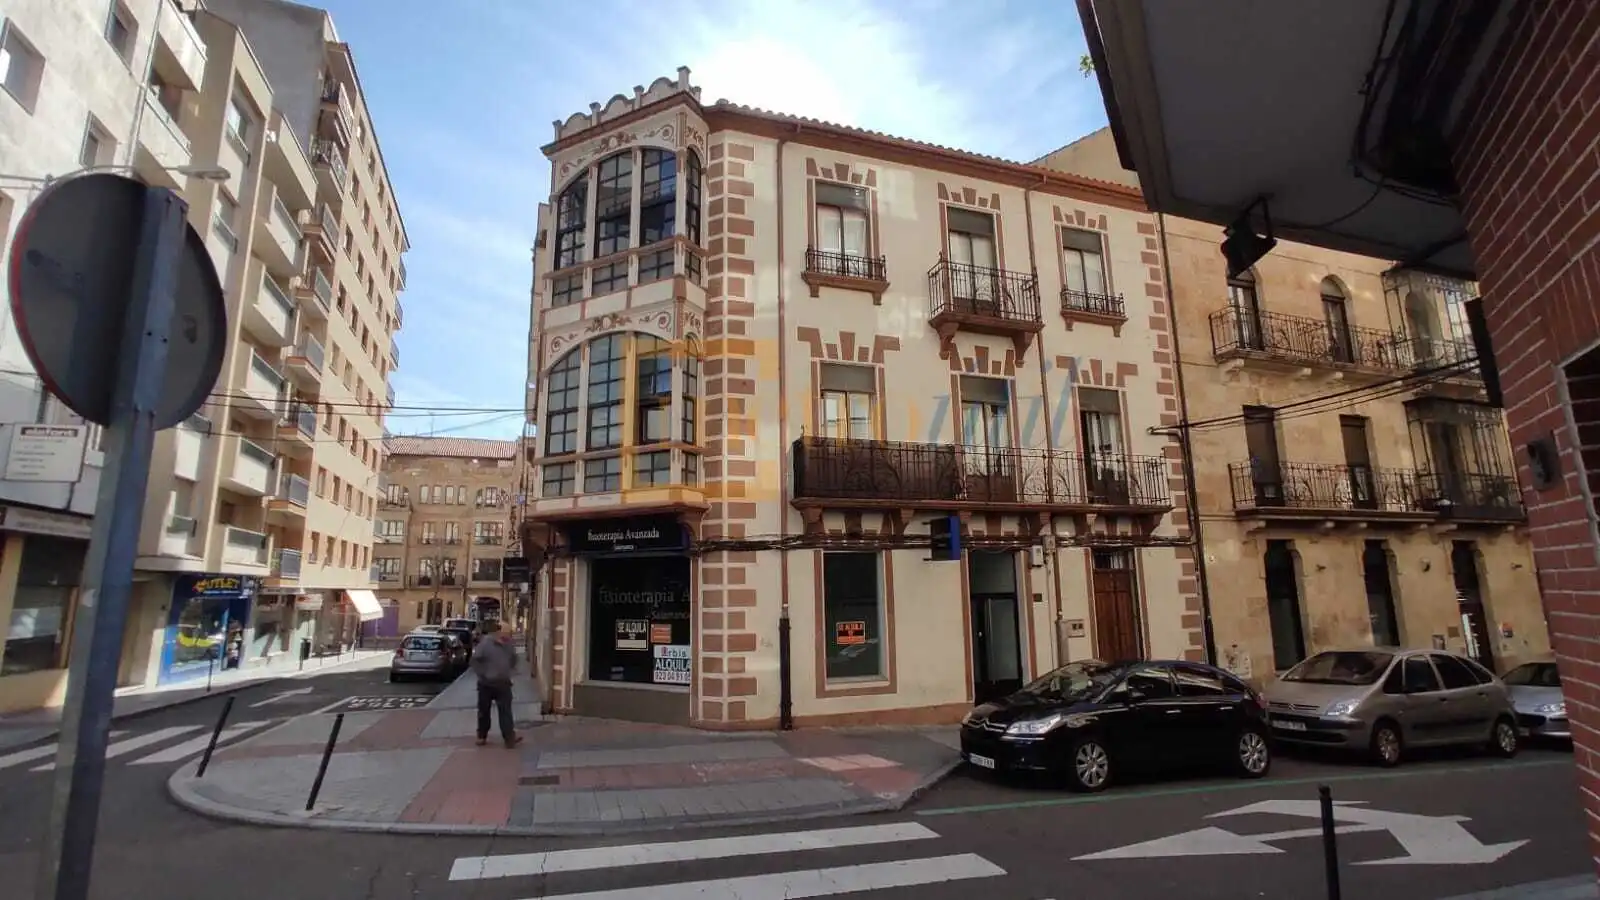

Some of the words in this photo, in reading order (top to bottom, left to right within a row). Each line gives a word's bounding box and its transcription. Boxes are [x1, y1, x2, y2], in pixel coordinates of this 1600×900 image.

[599, 585, 674, 608] fisioterapia
[618, 622, 625, 633] SE
[625, 622, 647, 633] ALQUILA
[655, 658, 690, 672] ALQUILA
